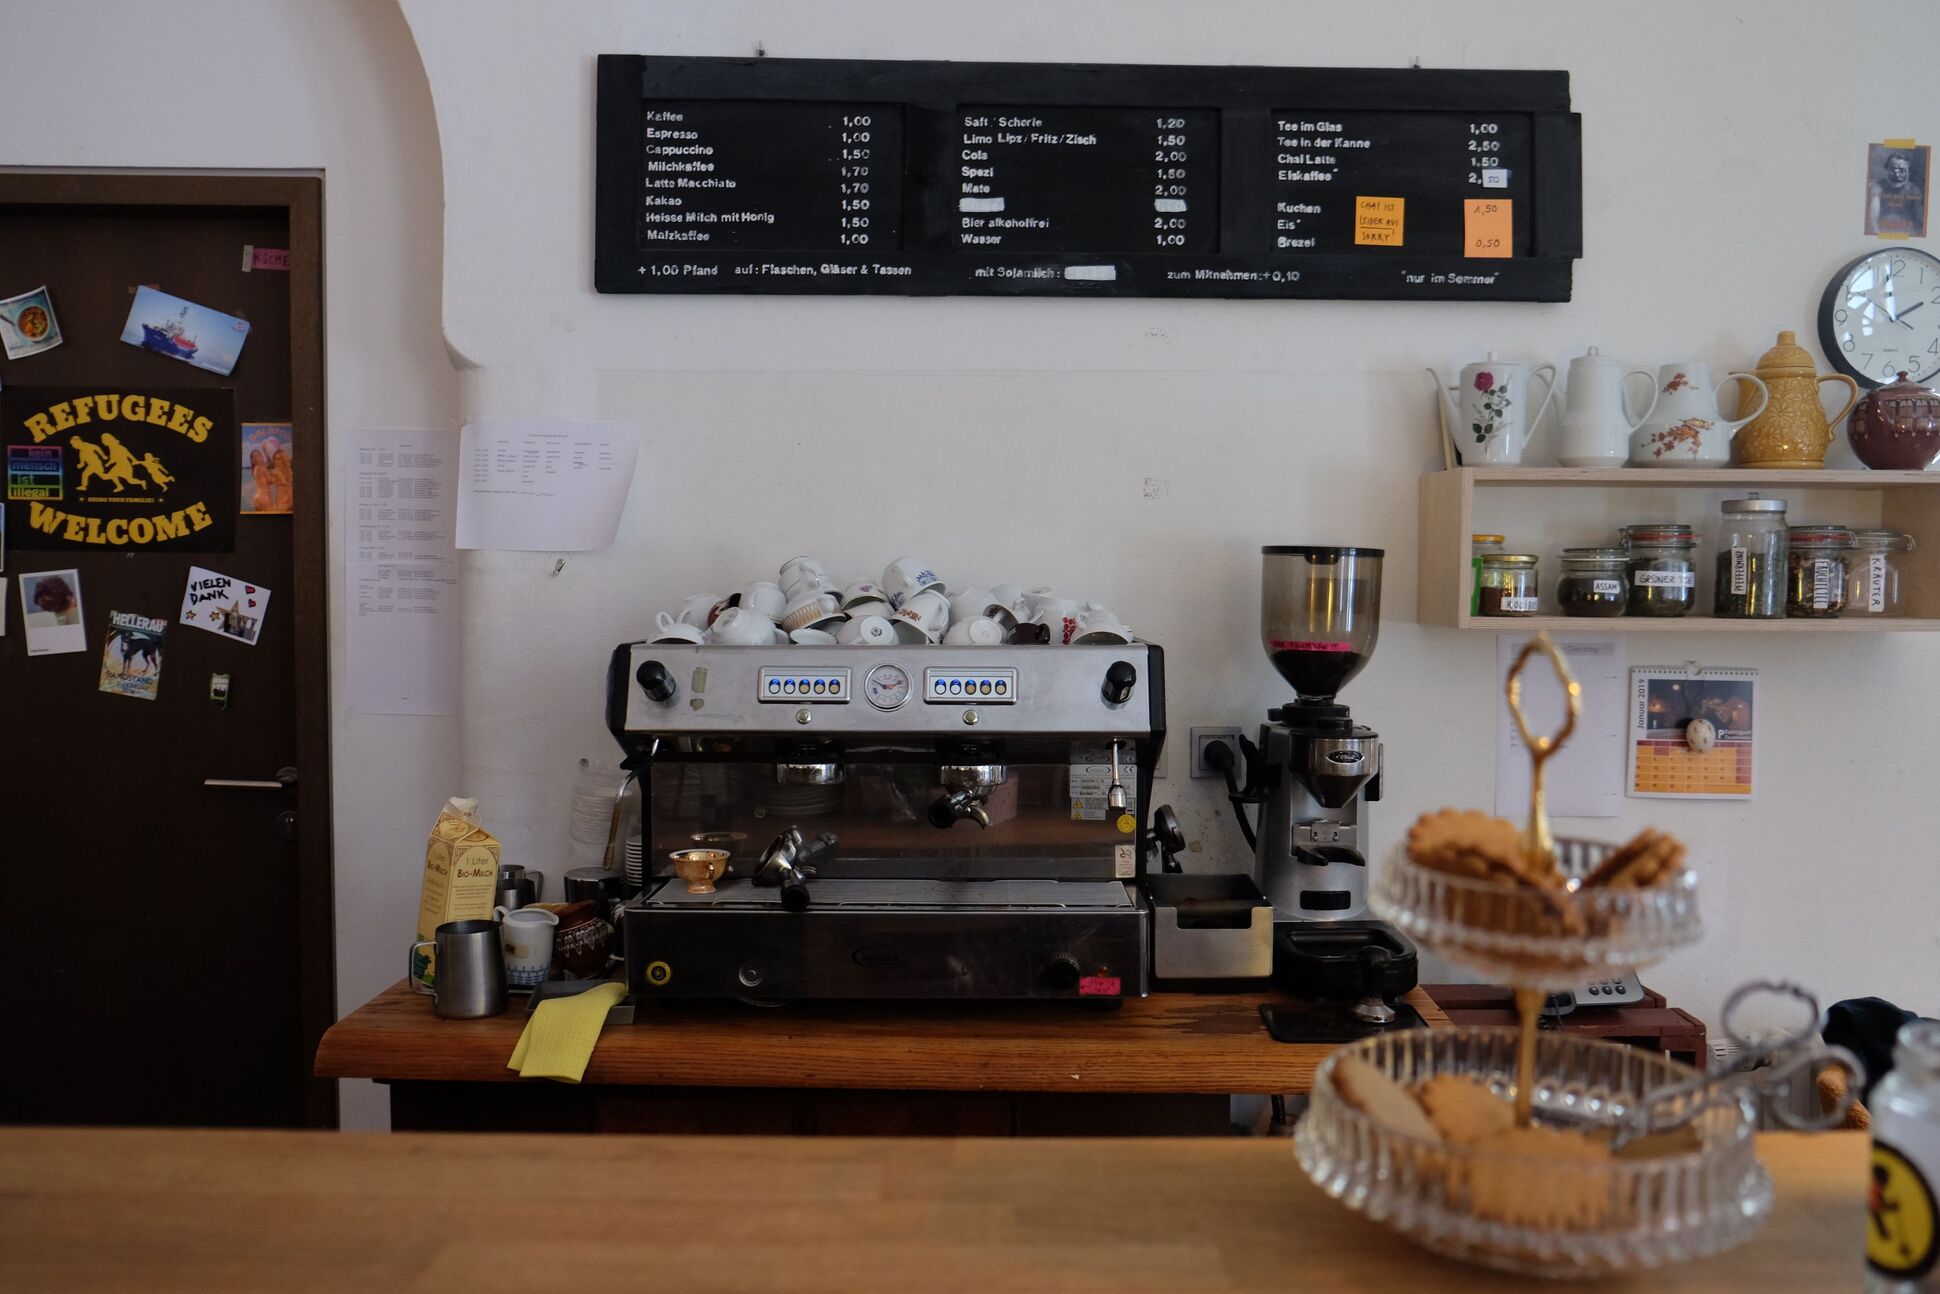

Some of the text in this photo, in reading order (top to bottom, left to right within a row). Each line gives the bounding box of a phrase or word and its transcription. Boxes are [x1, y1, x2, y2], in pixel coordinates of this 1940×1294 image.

[646, 111, 684, 122] Kaffee
[843, 116, 871, 128] 1,00
[964, 117, 988, 127] Saft
[998, 117, 1043, 128] Schorle
[1157, 118, 1186, 130] 1,20
[1277, 121, 1343, 132] Tee im Glas
[1469, 124, 1498, 135] 1,00
[646, 128, 698, 140] Espresso
[842, 132, 870, 144] 1,00
[963, 134, 993, 144] Limo
[1157, 135, 1186, 147] 1,50
[1277, 137, 1371, 148] Tee in der Kanne
[645, 145, 714, 156] Cappuccino
[842, 148, 870, 160] 1,50
[962, 150, 988, 160] Cola
[1155, 151, 1187, 163] 2,00
[1277, 154, 1337, 165] Chai Latte
[648, 161, 715, 172] Milchkaffee
[841, 166, 869, 178] 1,70
[961, 166, 994, 179] Spezi
[645, 178, 737, 189] Latte Macchiato
[841, 183, 869, 195] 1,70
[961, 182, 991, 194] Mate
[1155, 184, 1187, 197] 2,00
[645, 195, 682, 206] Kakao
[841, 199, 870, 211] 1,50
[1277, 203, 1321, 214] Kuchen
[645, 211, 775, 224] Heisse Milch mit Honig
[841, 217, 870, 229] 1,50
[961, 217, 1050, 229] Bier alkoholfrei
[1154, 217, 1187, 230] 2,00
[647, 229, 710, 241] Malzkaffee
[840, 233, 869, 246] 1,00
[961, 233, 1002, 244] Wasser
[1156, 234, 1185, 247] 1,00
[1277, 237, 1316, 249] Brezel
[1475, 239, 1501, 248] 0,50
[650, 265, 680, 277] 1,00
[683, 265, 719, 276] Pfand
[820, 263, 858, 275] Gläser
[872, 264, 913, 276] Tassen
[975, 267, 994, 278] mit
[1890, 259, 1906, 278] 12
[1167, 271, 1191, 279] zum
[1430, 273, 1445, 284] im
[1834, 308, 1848, 326] 9
[1927, 337, 1940, 356] 4
[1861, 352, 1873, 370] 7
[1908, 355, 1921, 373] 5
[1882, 360, 1896, 378] 6
[23, 394, 214, 444] REFUGEES
[28, 449, 52, 458] kein
[12, 461, 57, 471] mensch
[17, 474, 34, 485] ist
[12, 486, 50, 498] illegal
[29, 501, 214, 545] WELCOME
[190, 577, 231, 591] VIELEN
[1640, 573, 1676, 584] GRÜNER
[1871, 557, 1881, 607] KRÄUTER
[1594, 583, 1617, 591] ASSAM
[189, 589, 229, 605] DANK
[1638, 679, 1646, 729] Januar 2019
